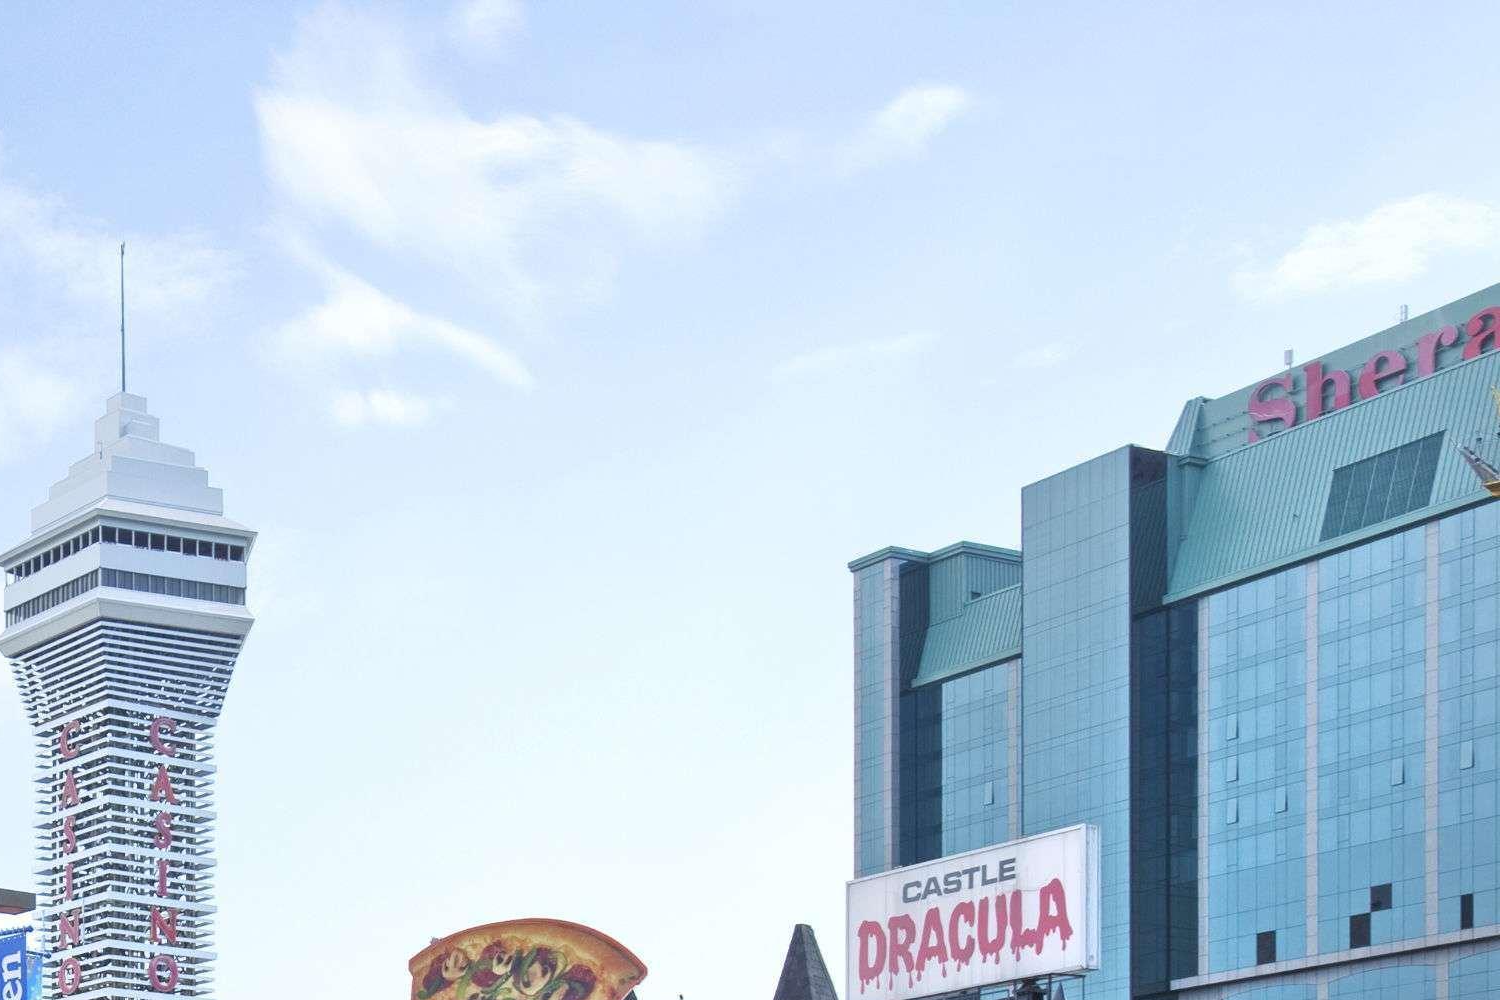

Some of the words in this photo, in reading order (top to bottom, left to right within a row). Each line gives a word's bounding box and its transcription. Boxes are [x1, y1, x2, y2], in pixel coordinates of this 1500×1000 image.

[57, 719, 82, 995] CASINO
[149, 716, 179, 992] CASINO
[858, 878, 1073, 994] DRACULA
[902, 858, 1016, 903] CASTLE
